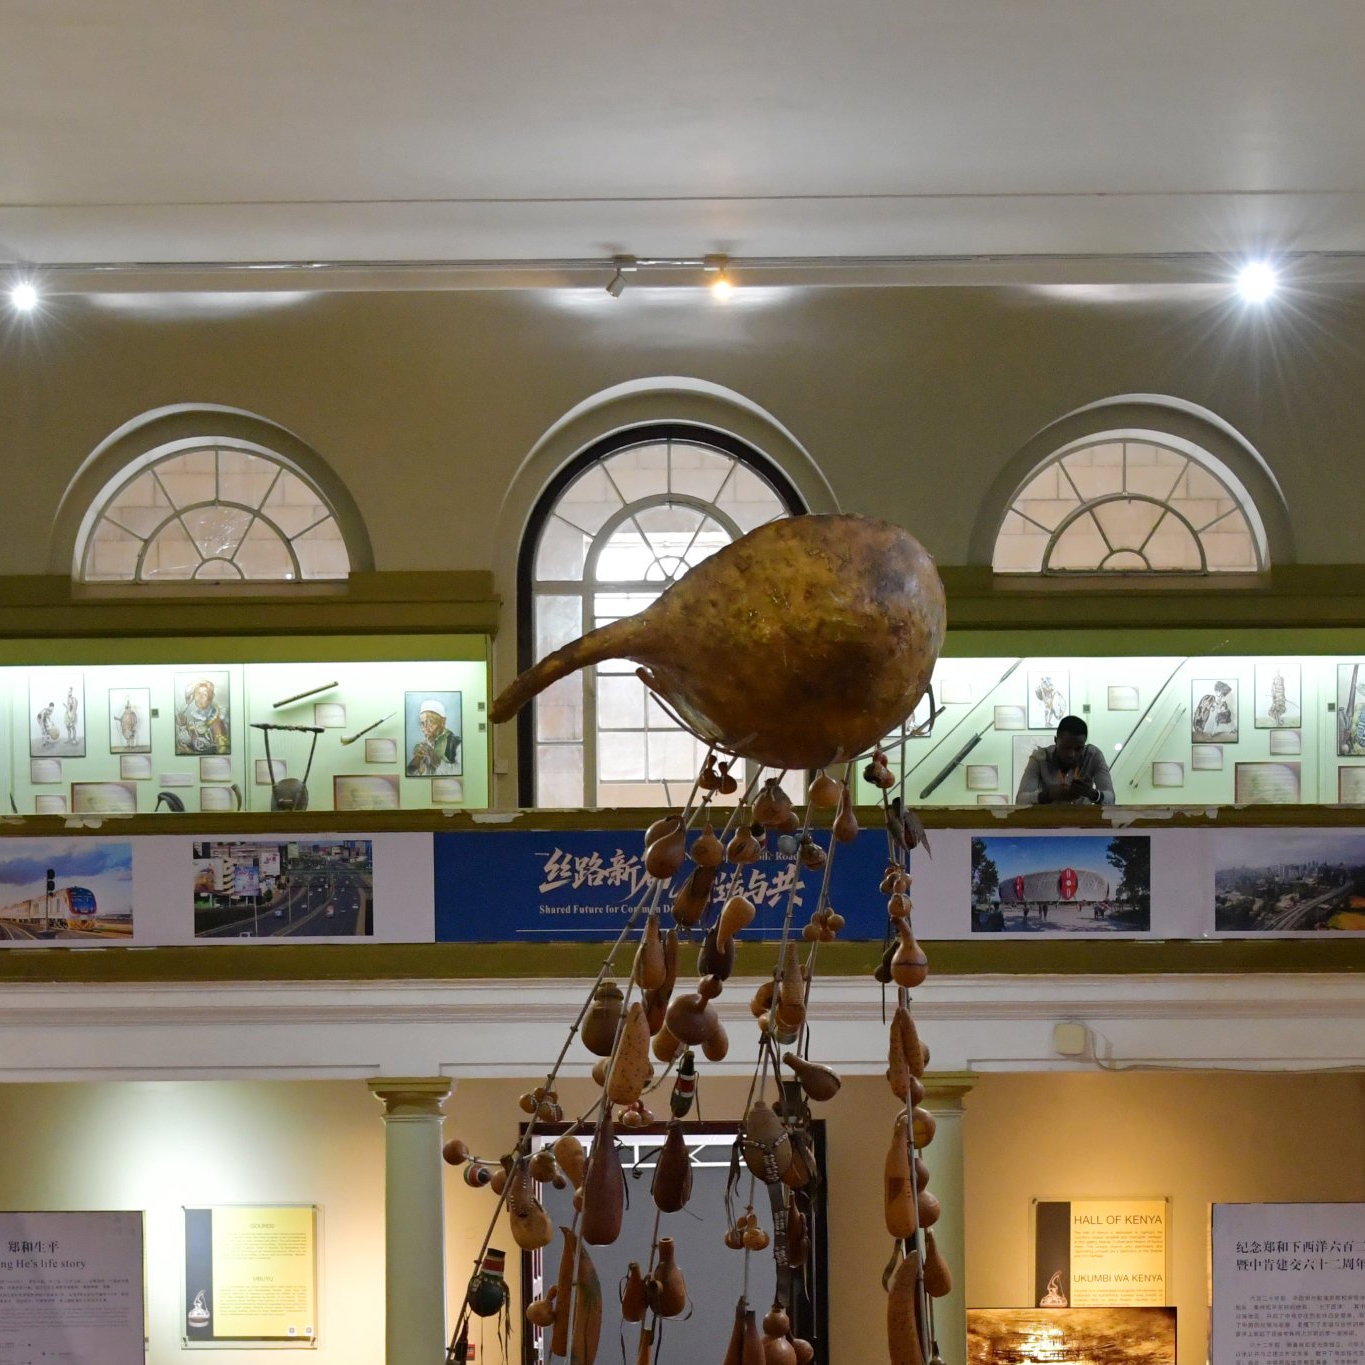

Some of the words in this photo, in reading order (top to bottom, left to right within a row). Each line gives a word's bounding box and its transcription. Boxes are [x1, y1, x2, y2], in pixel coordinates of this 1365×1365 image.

[538, 904, 570, 914] Shared
[573, 904, 603, 914] Future
[605, 904, 618, 914] for
[1074, 1215, 1103, 1224] HALL
[1106, 1215, 1121, 1224] OF
[1124, 1215, 1162, 1224] KENYA
[8, 1239, 59, 1253] 郑和生平
[15, 1258, 37, 1268] He's
[40, 1258, 57, 1268] life
[60, 1260, 86, 1270] story
[1073, 1273, 1111, 1282] UKUMBI
[1113, 1273, 1129, 1282] WA
[1131, 1273, 1163, 1282] KENYA
